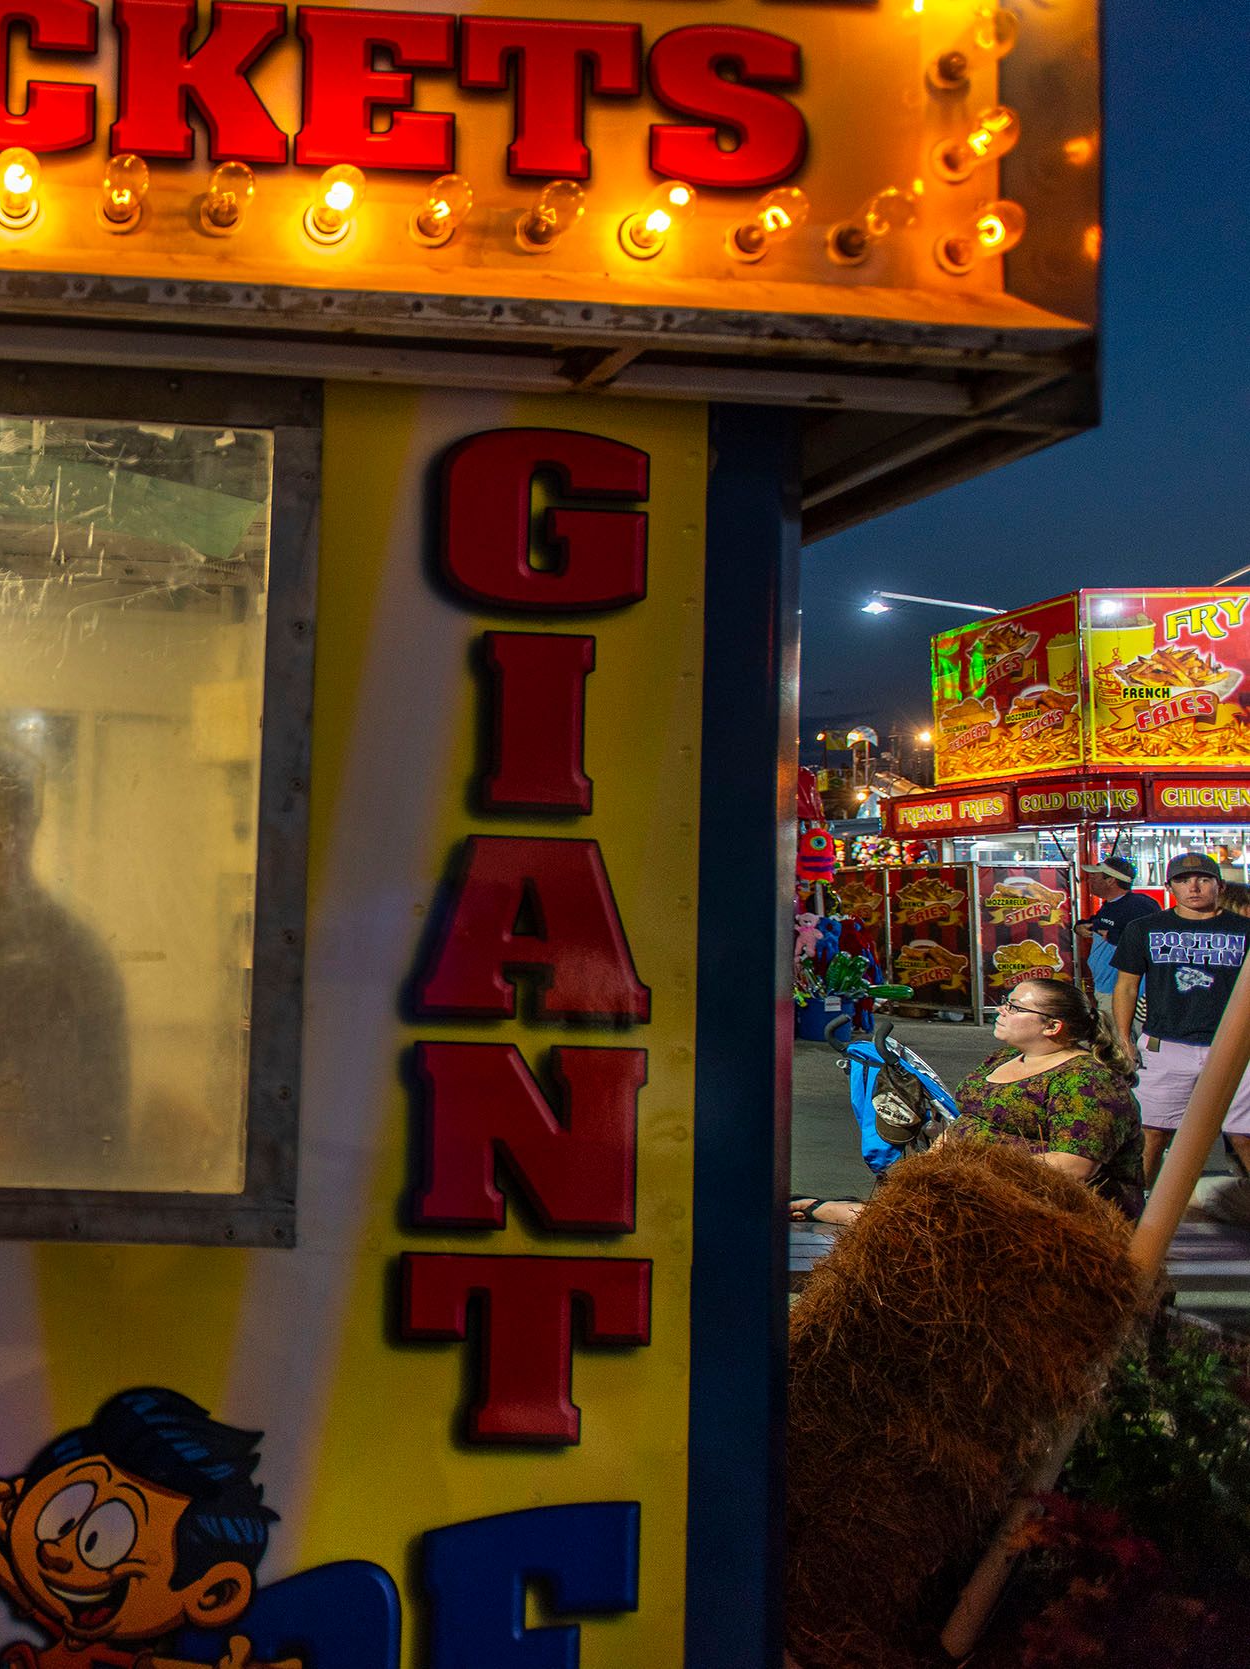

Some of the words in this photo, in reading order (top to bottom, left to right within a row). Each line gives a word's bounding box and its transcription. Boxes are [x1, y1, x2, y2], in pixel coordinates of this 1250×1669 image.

[1165, 597, 1249, 640] FRY
[1122, 687, 1170, 699] FRENCH
[1006, 709, 1041, 723] MOZZARELLA
[1136, 694, 1214, 732] FRIES
[1022, 710, 1063, 739] STICKS
[949, 724, 989, 751] TENDERS
[1019, 793, 1064, 813] COLD
[1067, 789, 1139, 813] DRINKS
[899, 803, 952, 828] FRENCH
[959, 797, 1004, 822] FRIES
[986, 898, 1028, 906] MOZZARELLA
[909, 905, 949, 923] FRIES
[1005, 905, 1051, 924] STICKS
[403, 427, 653, 1446] GIANT
[1149, 932, 1246, 951] BOSTON
[1151, 947, 1245, 967] LATIN
[911, 967, 951, 987] STICKS
[1005, 967, 1051, 987] TENDERS
